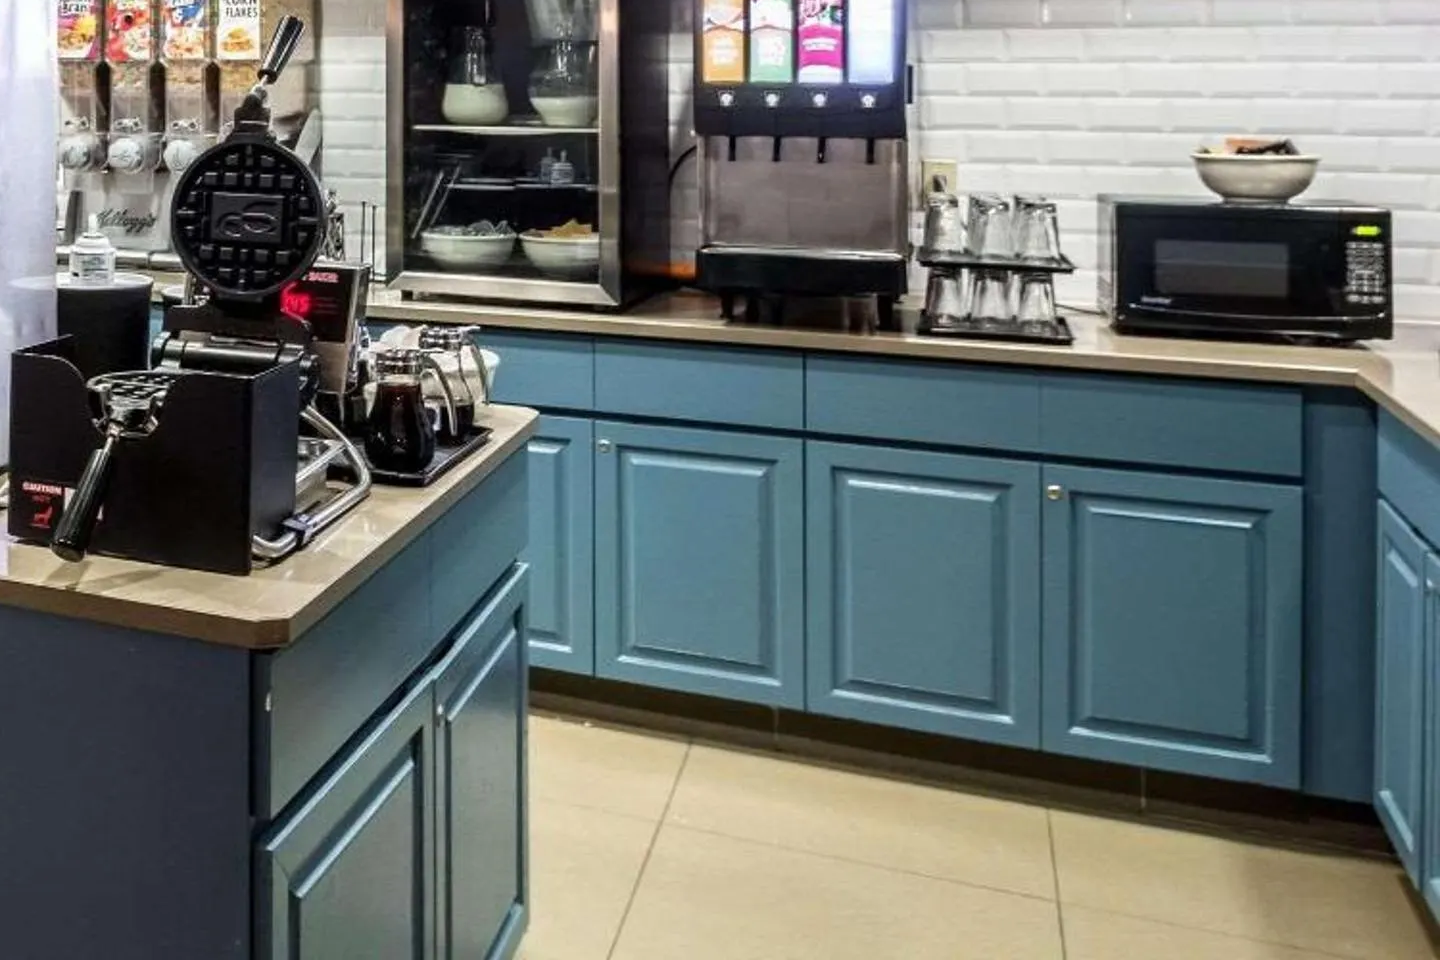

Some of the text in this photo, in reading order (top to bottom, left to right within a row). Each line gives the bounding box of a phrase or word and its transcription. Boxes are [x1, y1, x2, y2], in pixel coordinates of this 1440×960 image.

[225, 7, 258, 18] FLAKES
[97, 208, 156, 233] Kellogg's
[22, 481, 62, 496] CAUTION
